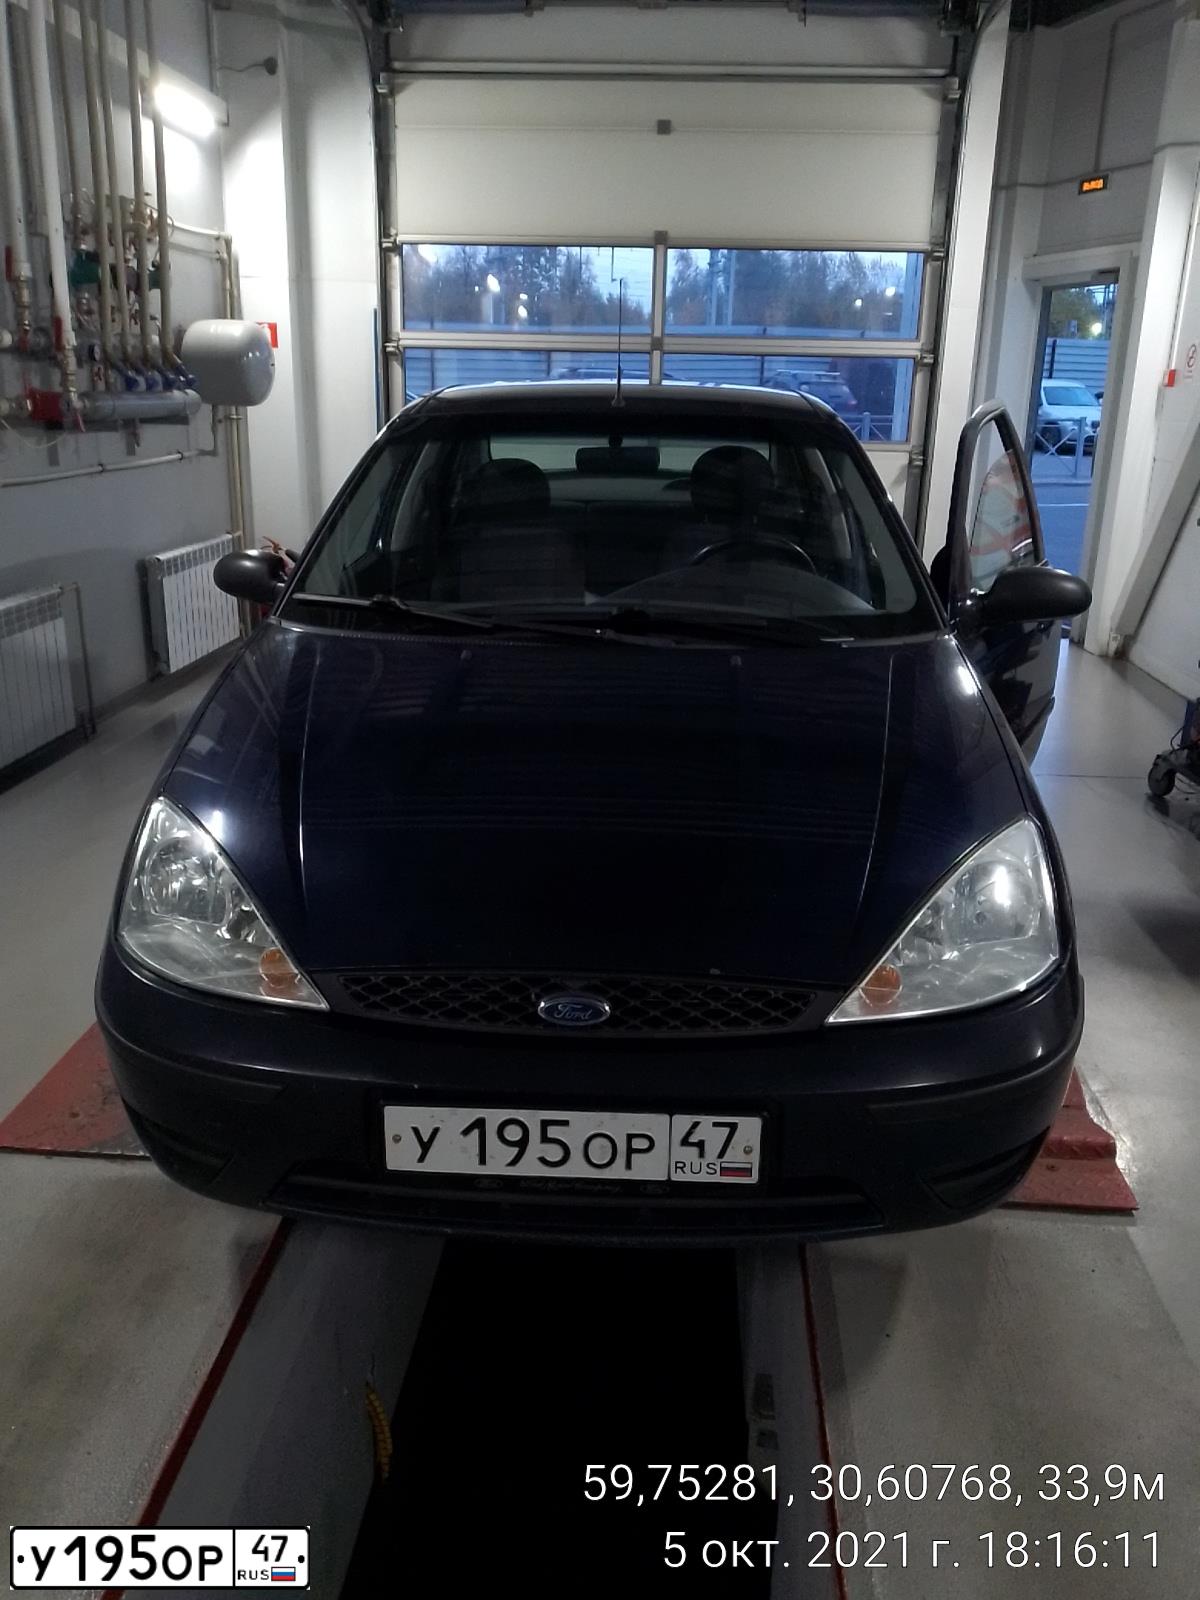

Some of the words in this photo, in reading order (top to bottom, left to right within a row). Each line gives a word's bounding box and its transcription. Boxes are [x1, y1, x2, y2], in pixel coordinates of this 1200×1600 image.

[554, 1003, 593, 1020] Ford
[679, 1120, 739, 1160] 47
[673, 1160, 718, 1175] RUS
